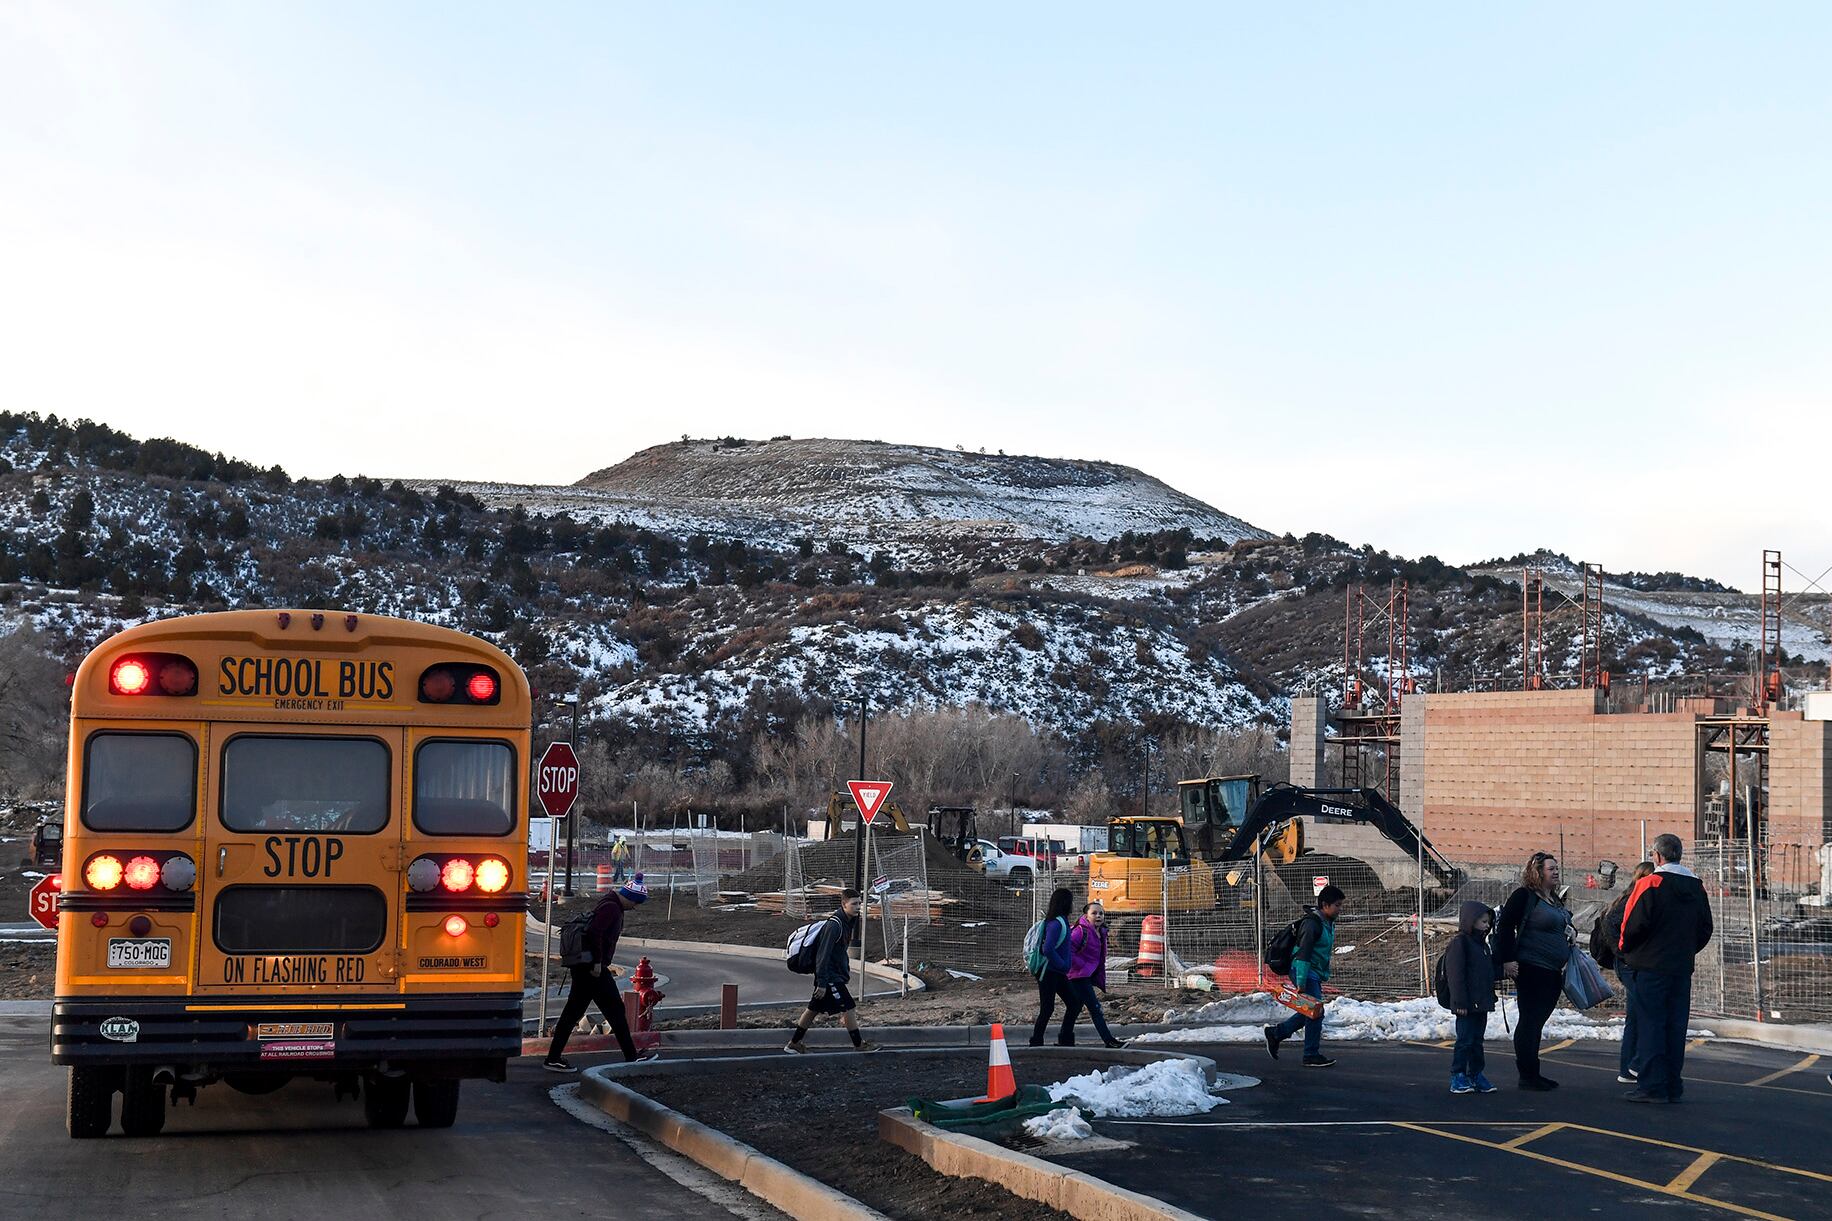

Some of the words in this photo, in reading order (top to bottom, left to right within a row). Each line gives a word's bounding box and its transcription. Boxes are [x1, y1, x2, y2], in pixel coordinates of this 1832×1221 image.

[220, 656, 329, 697] SCHOOL
[339, 661, 394, 700] BUS
[274, 699, 323, 711] EMERGENCY
[327, 700, 345, 711] EXIT
[541, 766, 577, 793] STOP
[1321, 804, 1353, 817] DEERE
[263, 836, 344, 878] STOP
[37, 892, 60, 912] ST
[224, 957, 245, 983] ON
[253, 957, 327, 983] FLASHING
[336, 957, 365, 983] RED
